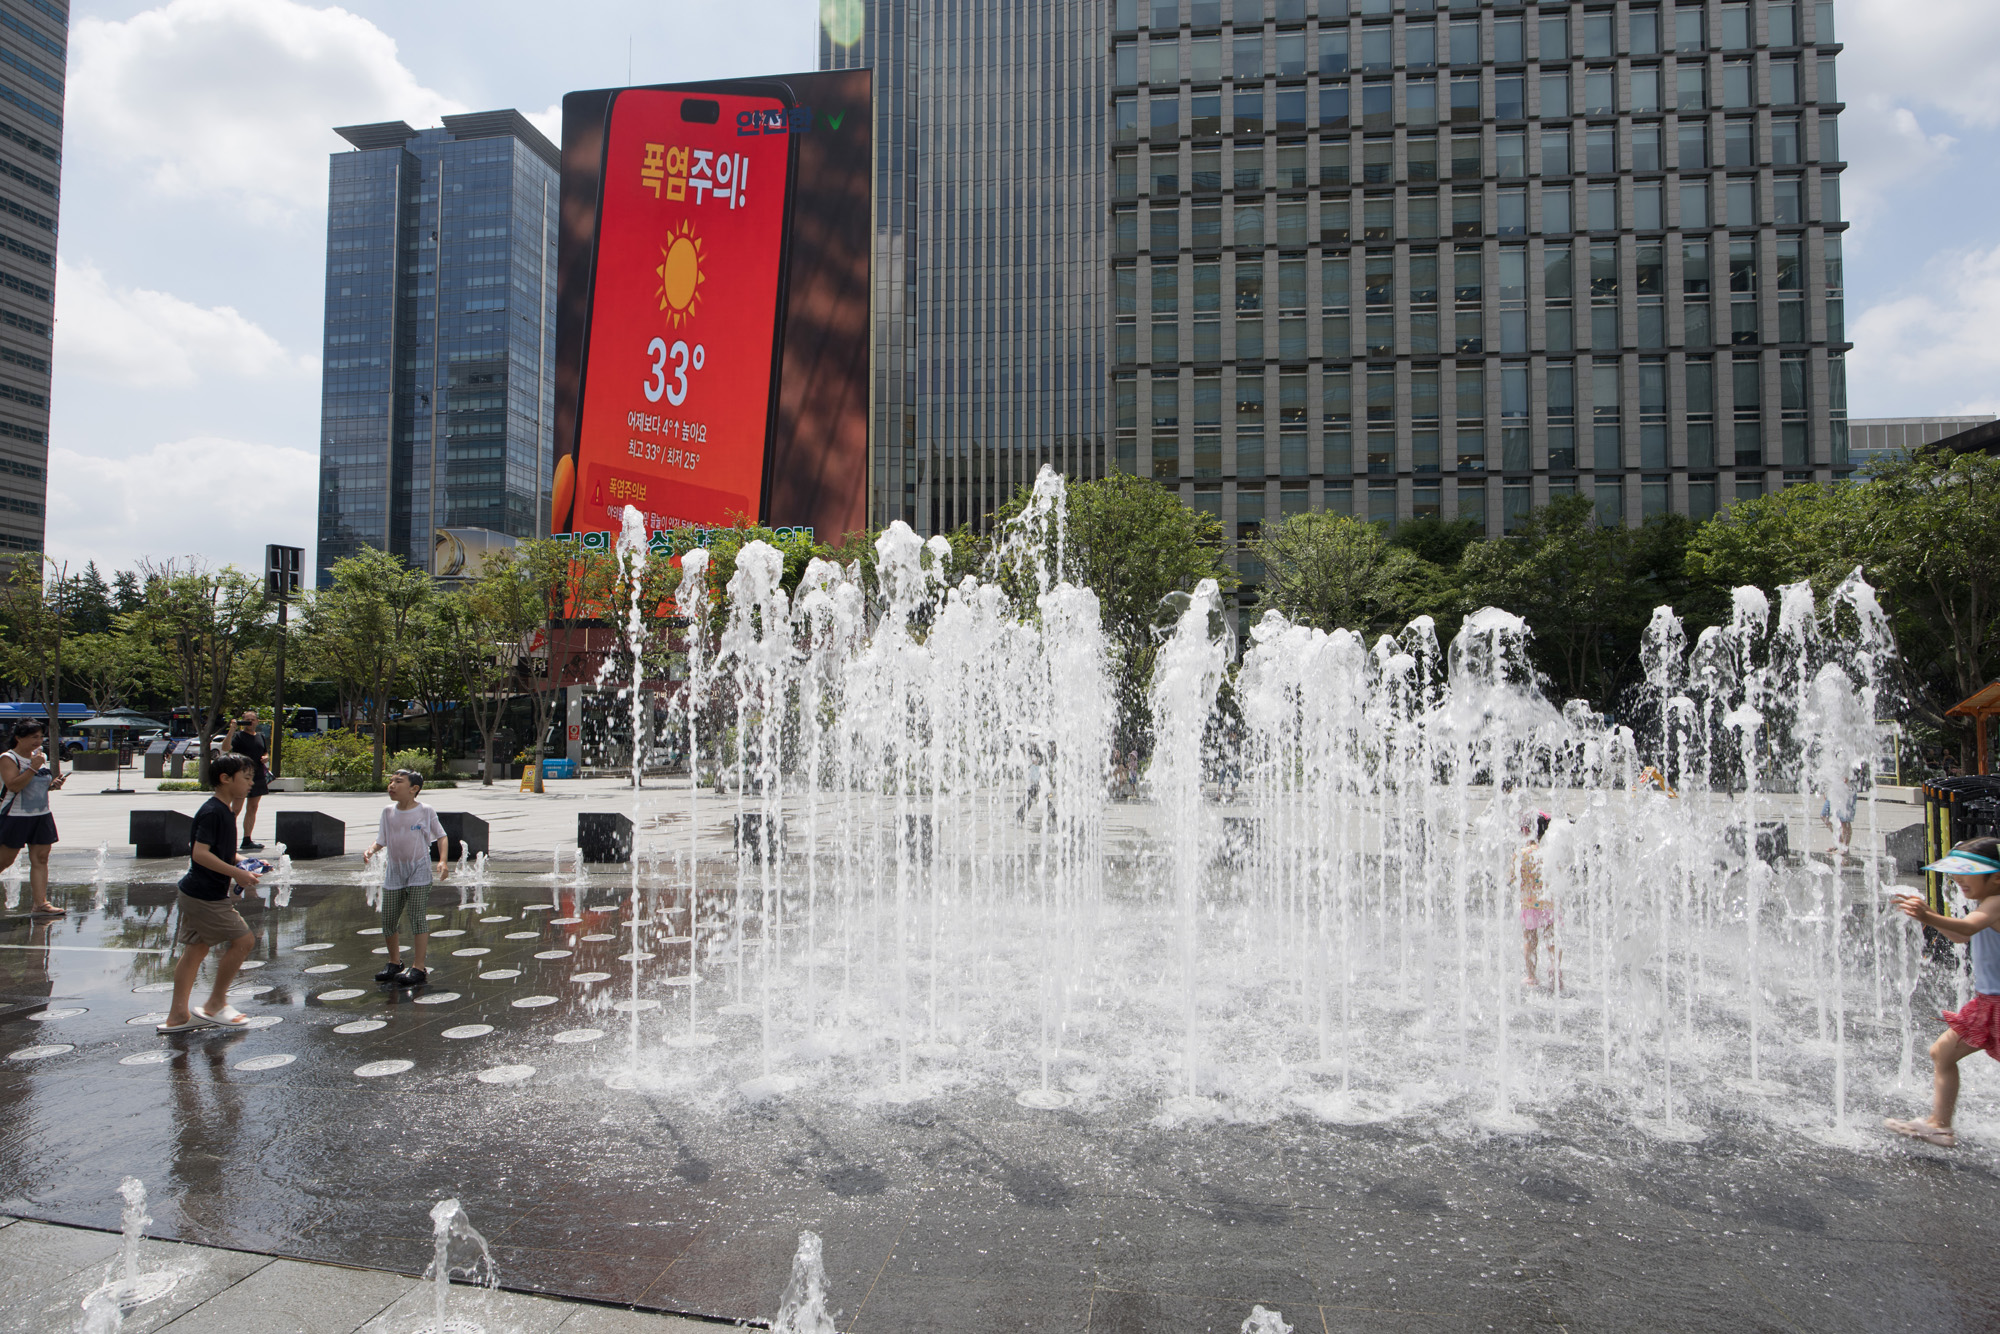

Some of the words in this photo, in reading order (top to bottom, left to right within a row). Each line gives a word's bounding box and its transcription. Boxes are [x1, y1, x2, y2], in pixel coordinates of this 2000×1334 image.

[641, 142, 749, 210] 폭염주의!
[643, 336, 706, 407] 33°
[627, 410, 661, 436] 어제보다
[681, 420, 707, 443] 높아요
[628, 438, 644, 458] 최고
[667, 447, 683, 468] 최저
[609, 477, 647, 502] 폭염주의보
